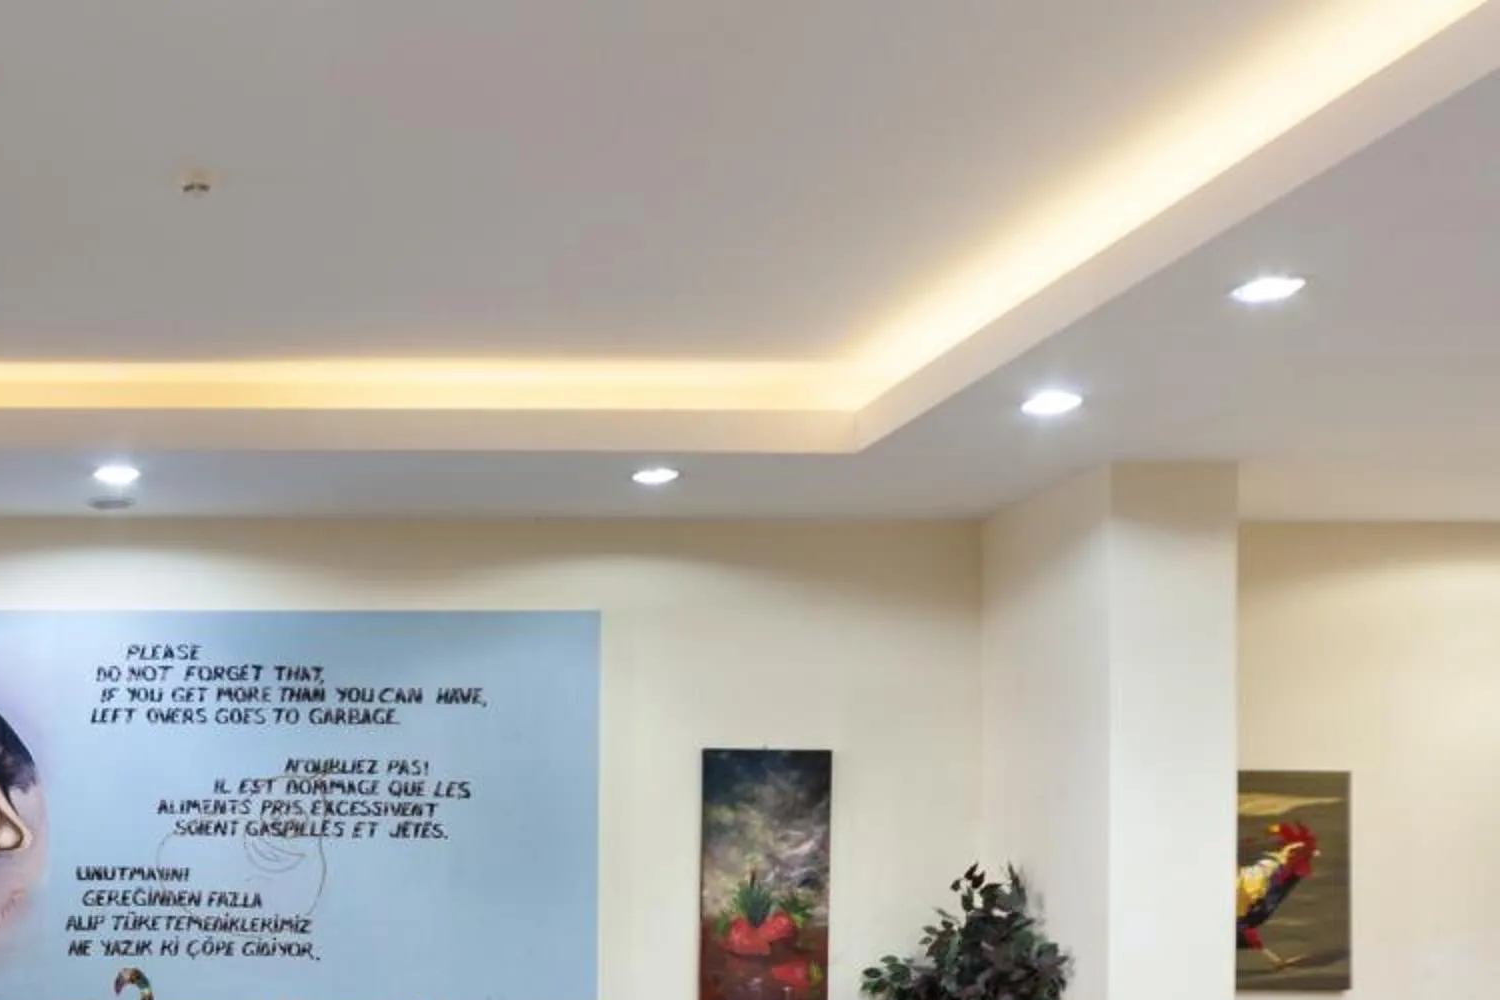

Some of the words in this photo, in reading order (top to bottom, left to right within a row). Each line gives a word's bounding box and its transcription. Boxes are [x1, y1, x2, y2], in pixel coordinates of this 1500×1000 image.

[125, 644, 201, 661] PLEASE
[95, 667, 122, 683] DO
[126, 666, 174, 683] NOT
[183, 664, 264, 683] FORGET
[273, 666, 324, 685] THAT,
[100, 688, 119, 704] IF
[126, 687, 163, 704] YOU
[170, 687, 208, 704] GET
[215, 687, 271, 704] MORE
[279, 687, 325, 704] THAN
[334, 688, 374, 704] YOU
[377, 687, 424, 705] CAN
[435, 687, 488, 707] HAVE,
[89, 708, 137, 725] LEFT
[145, 707, 208, 725] OVERS
[213, 707, 267, 725] GOES
[271, 708, 300, 725] TO
[386, 758, 430, 776] PAS!
[213, 778, 232, 794] IL
[238, 777, 277, 797] EST
[387, 779, 426, 797] QUE
[432, 780, 472, 799] LES
[156, 799, 252, 815] ALIMENTS
[260, 799, 304, 815] PRIS
[172, 818, 239, 837] SOIENT
[351, 820, 379, 838] ET
[206, 891, 263, 909] FAZLA
[67, 939, 92, 956] NE
